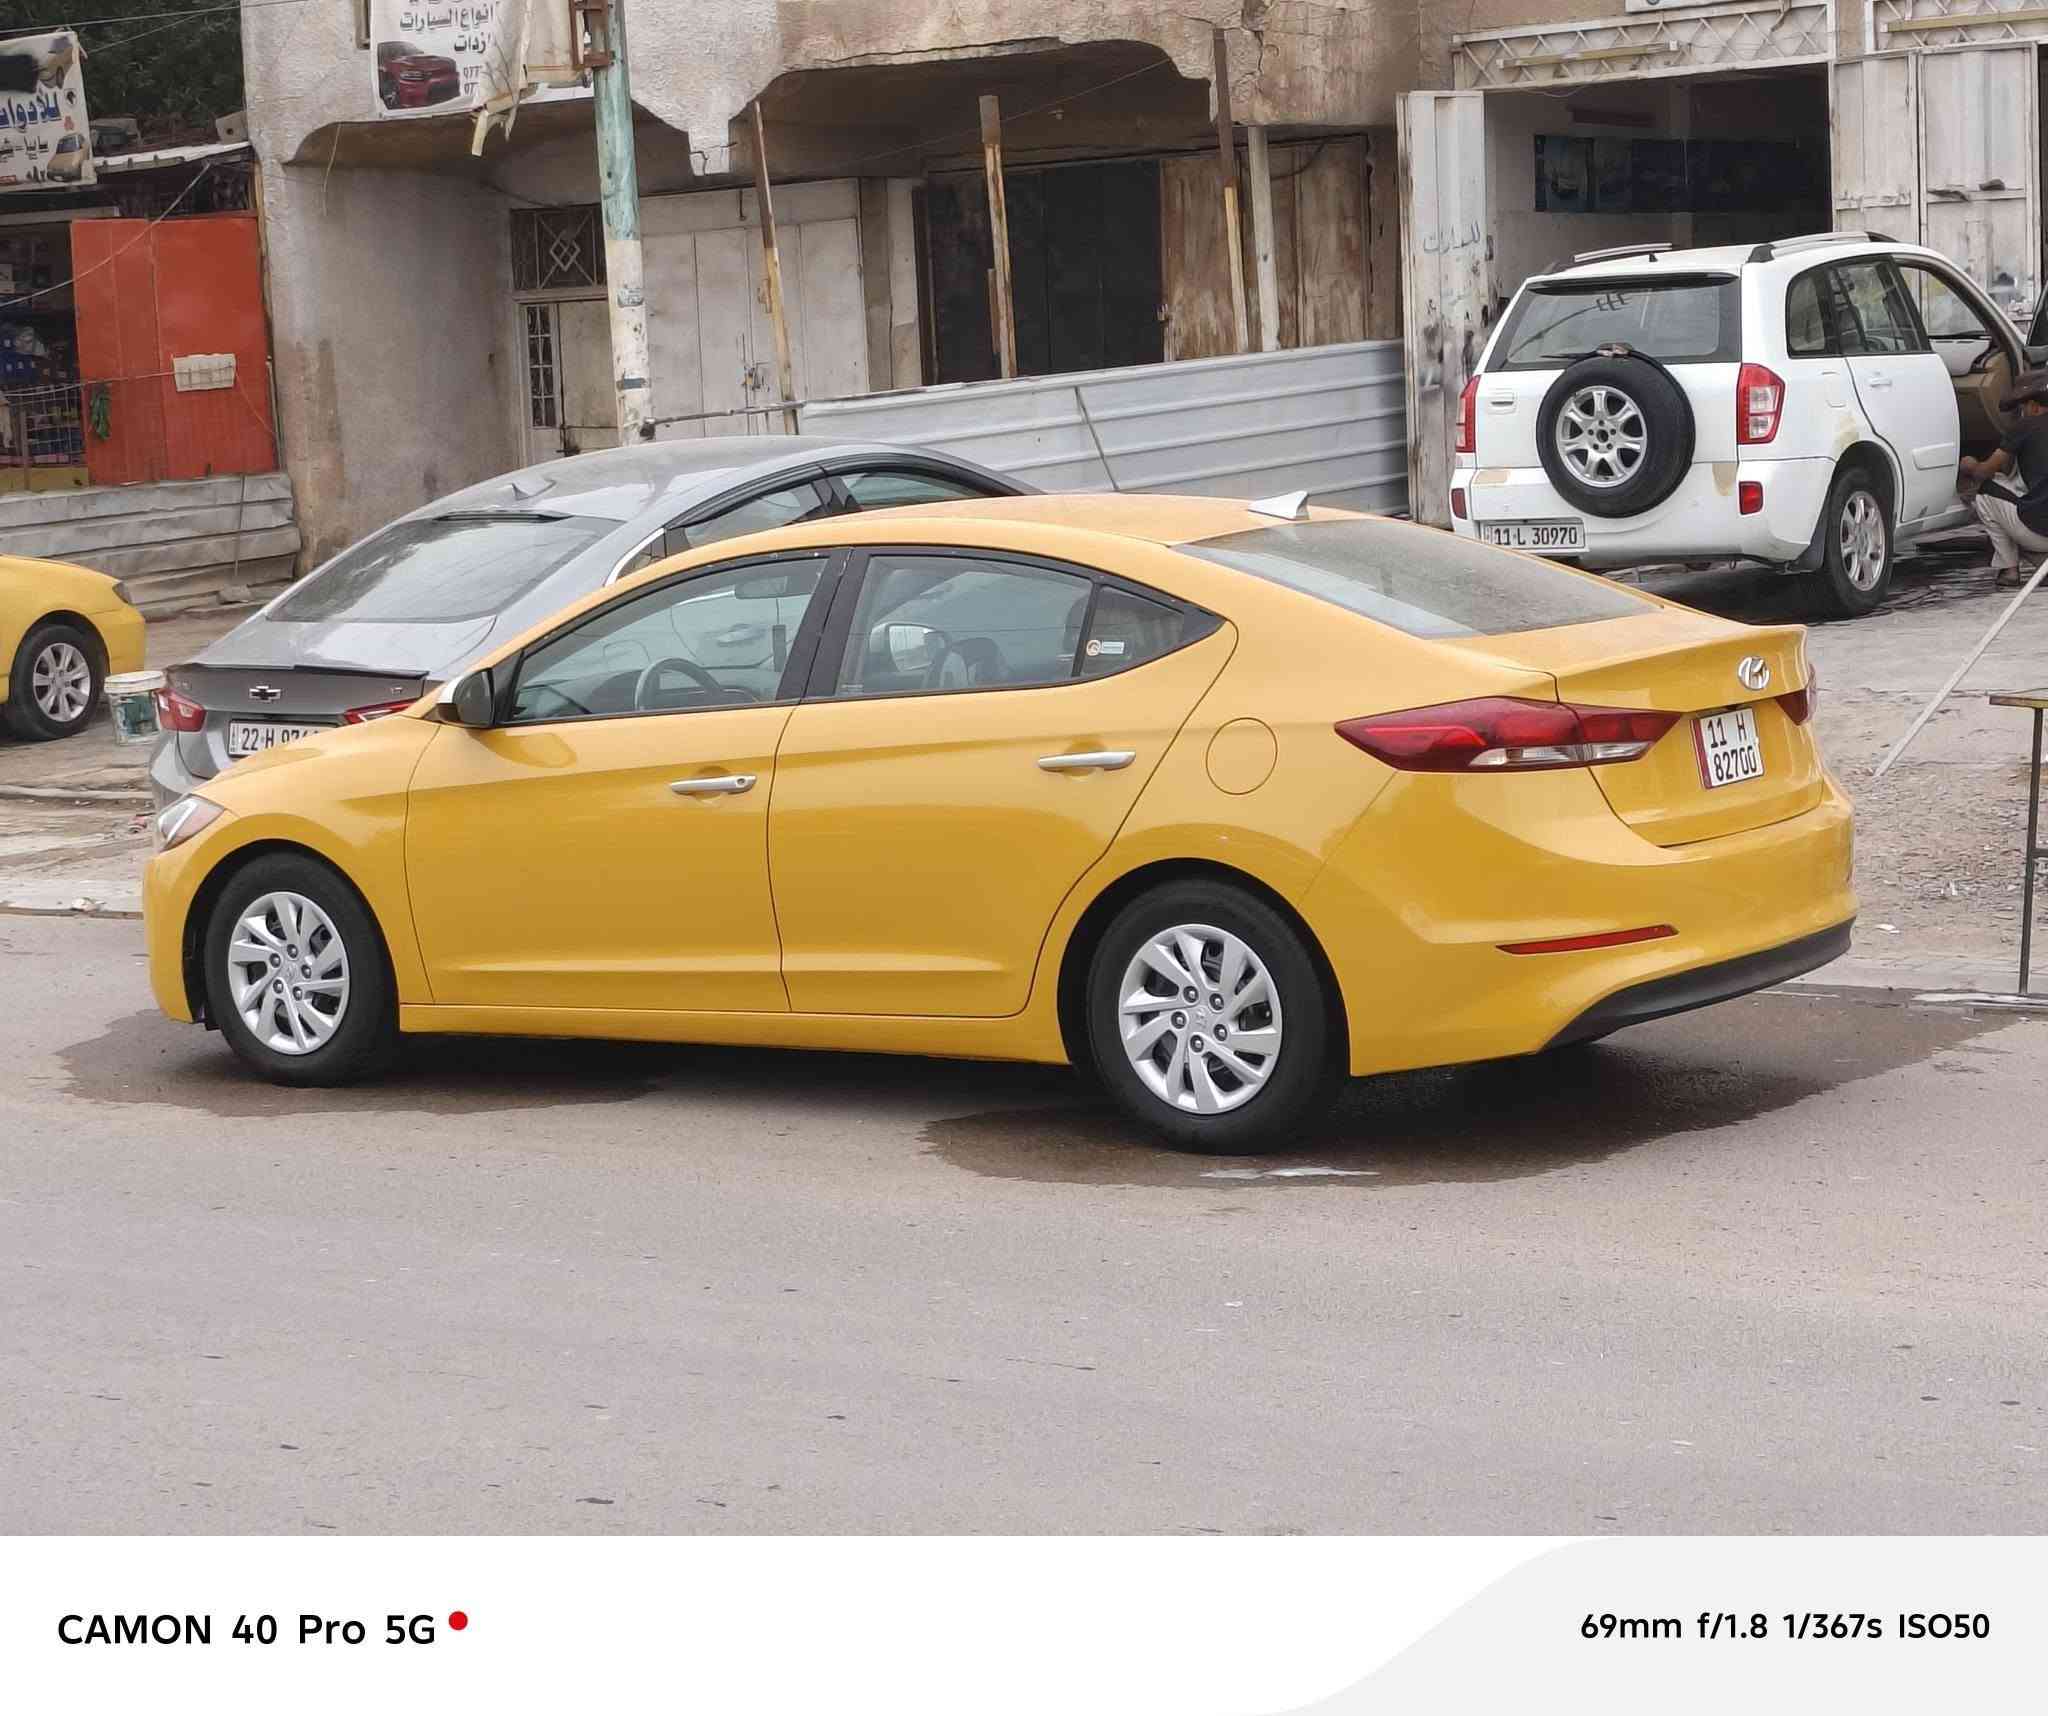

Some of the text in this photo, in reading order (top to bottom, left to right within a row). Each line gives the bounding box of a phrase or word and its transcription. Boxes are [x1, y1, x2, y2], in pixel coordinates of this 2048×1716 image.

[399, 7, 458, 32] السيارات
[1494, 527, 1578, 545] 11 L 30970
[242, 728, 259, 751] 22
[265, 728, 275, 748] H
[1707, 712, 1748, 749] 11 H
[1713, 746, 1757, 782] 82700
